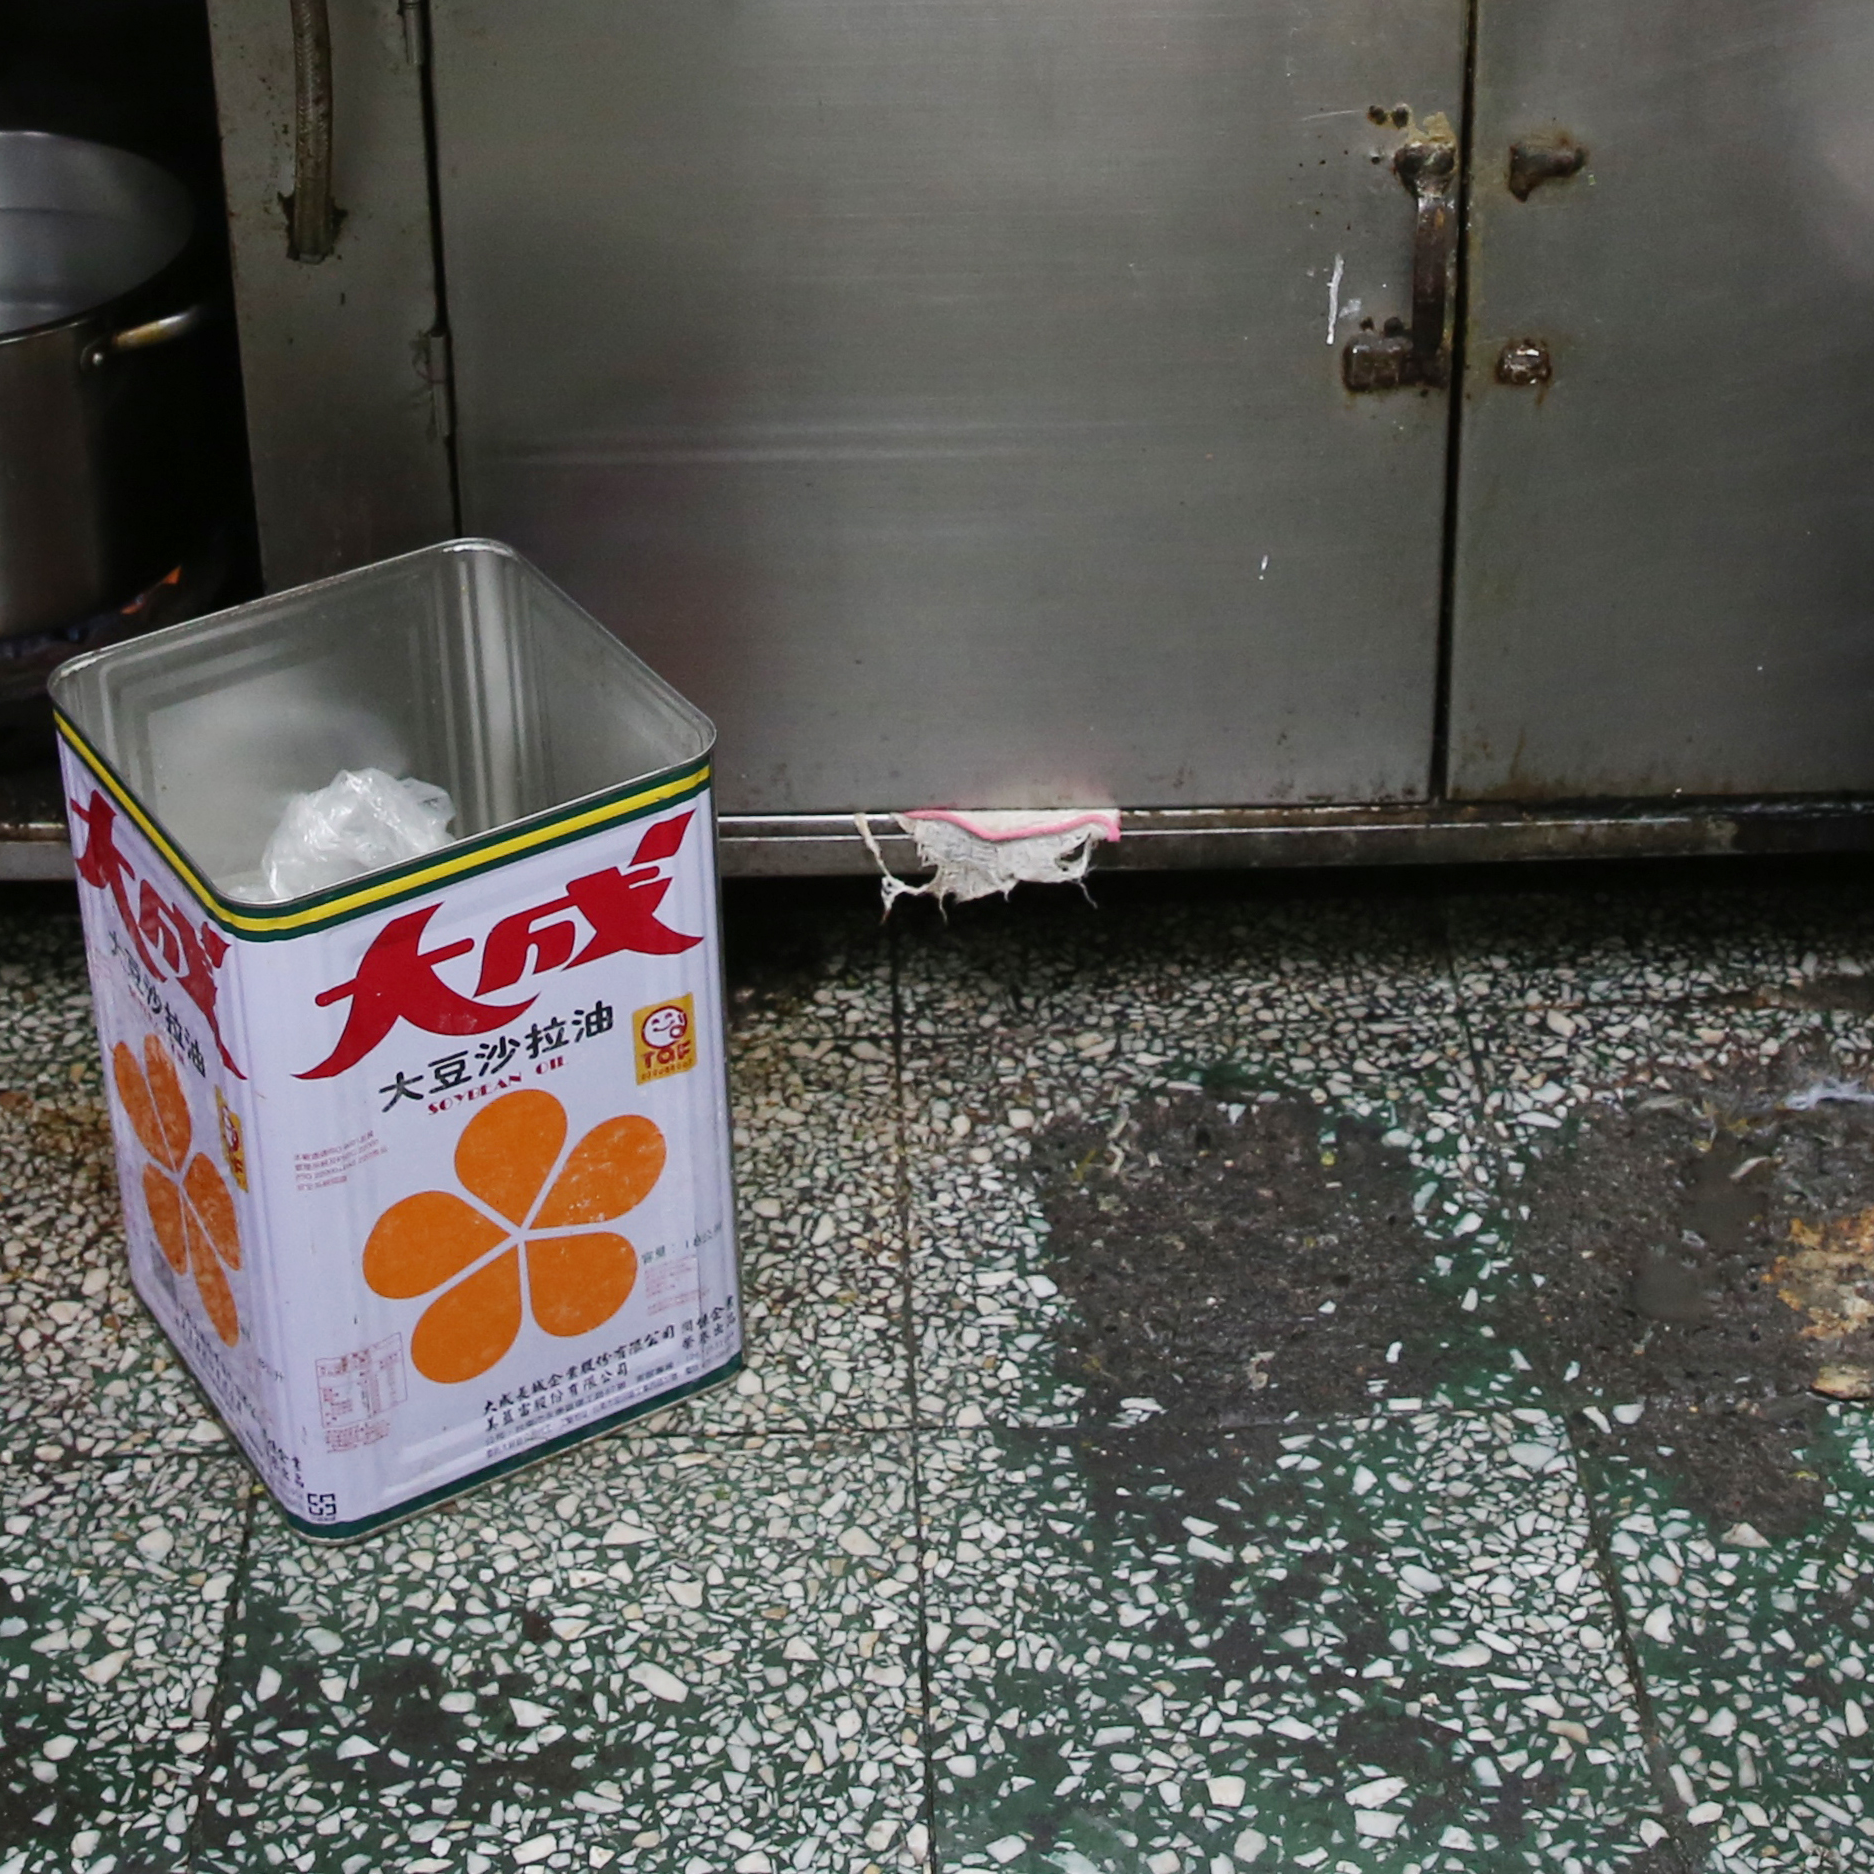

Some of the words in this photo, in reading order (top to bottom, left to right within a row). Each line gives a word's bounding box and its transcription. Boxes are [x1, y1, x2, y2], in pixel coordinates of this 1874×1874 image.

[292, 809, 705, 1080] 大成
[379, 1000, 614, 1113] 大豆沙拉油
[428, 1072, 522, 1115] SOYBEAN
[535, 1056, 567, 1076] OIL
